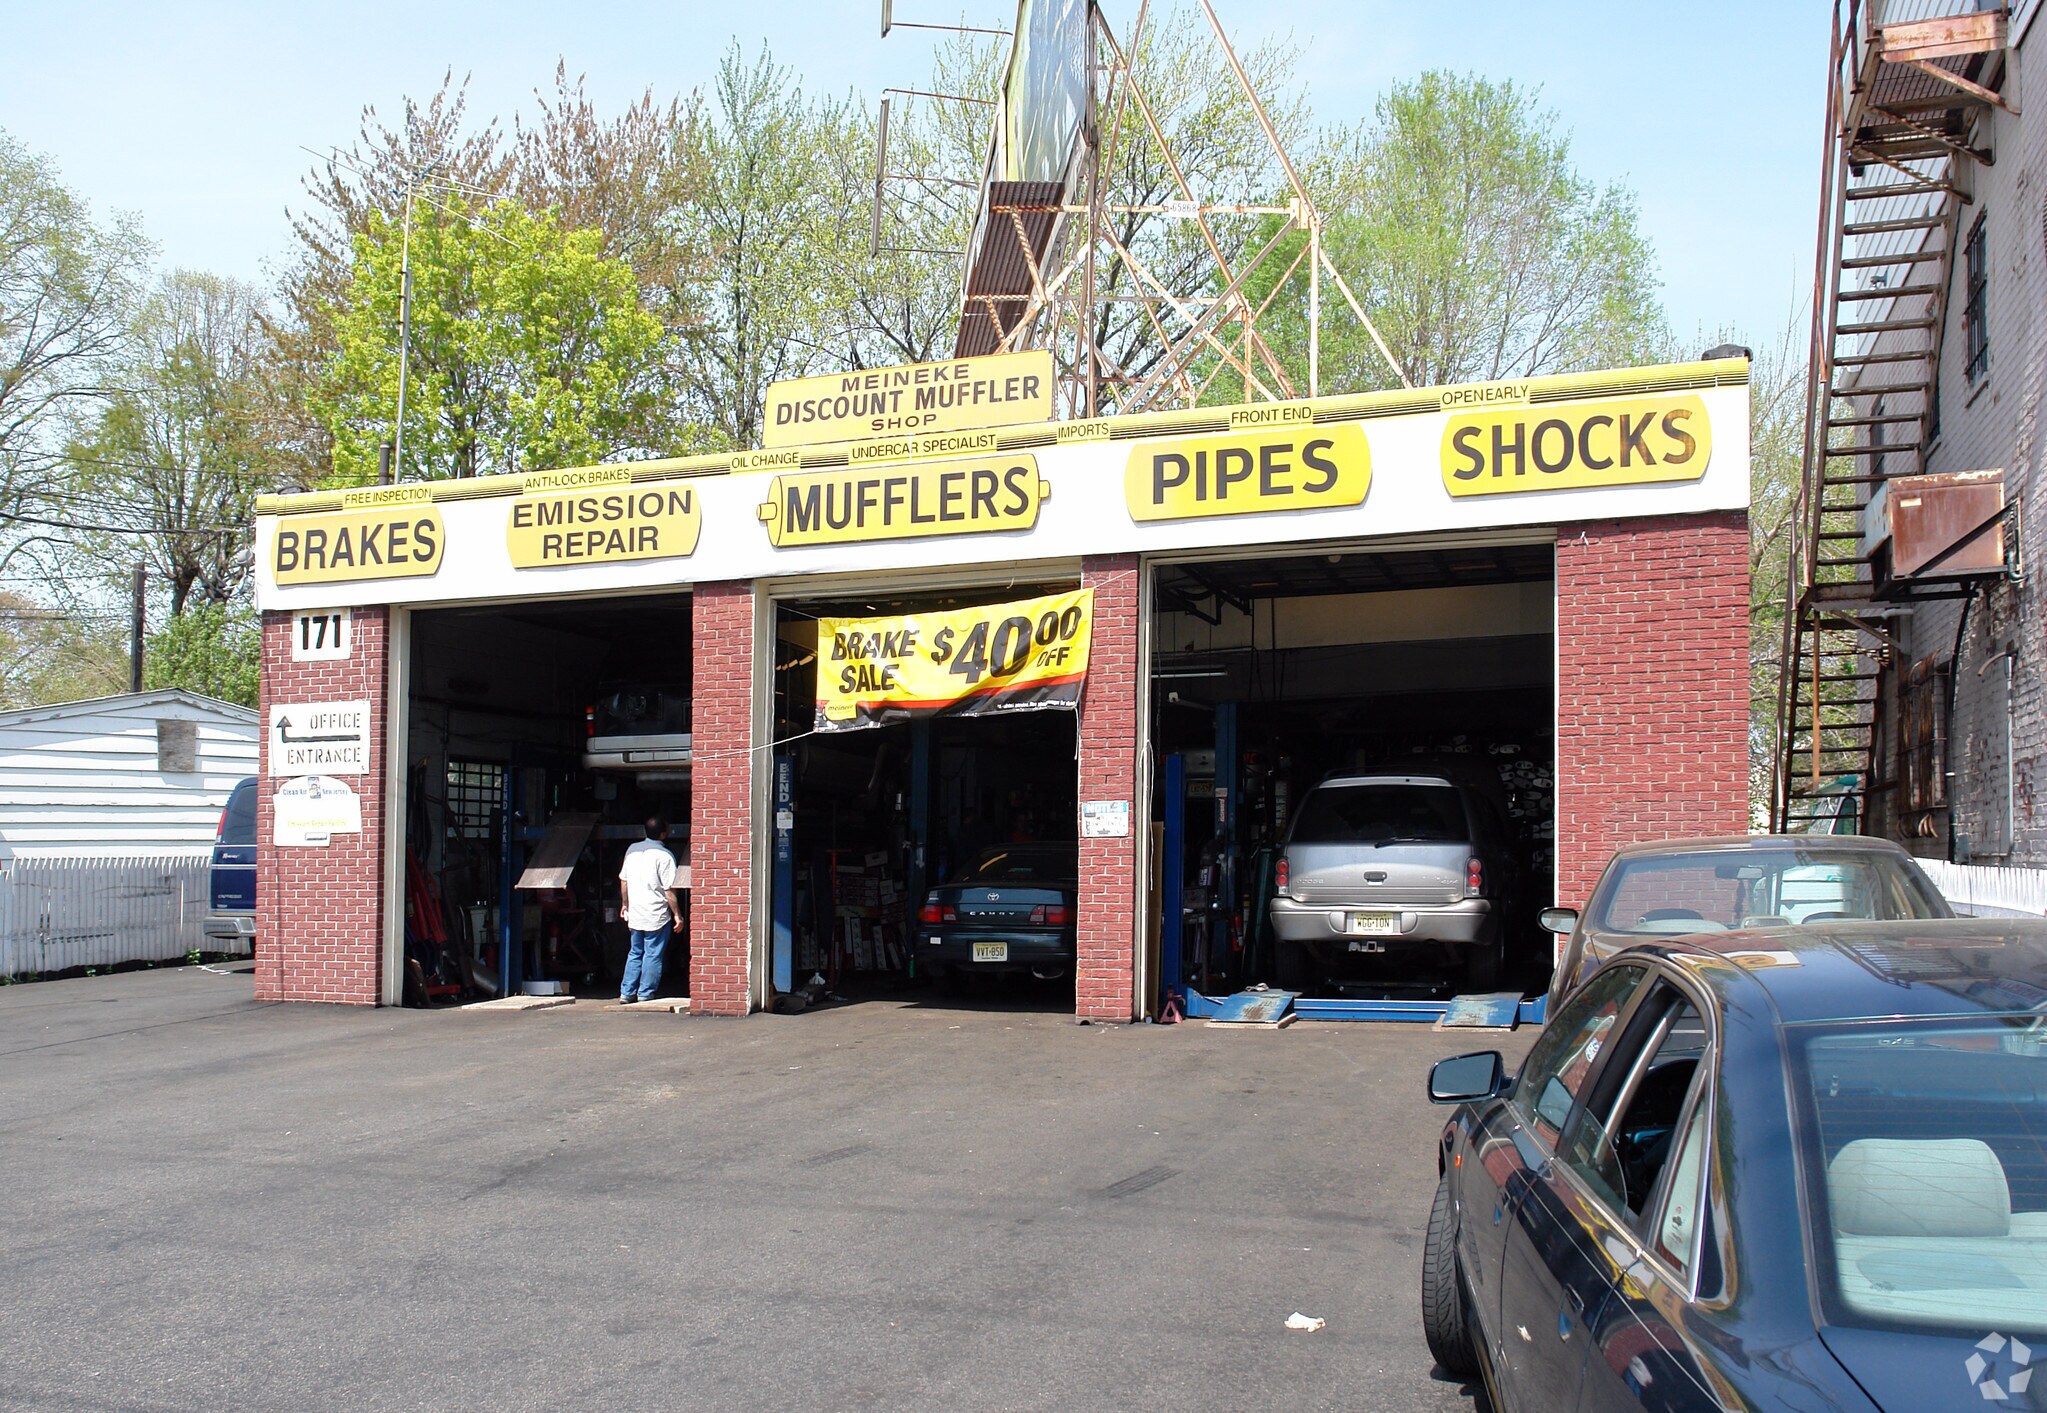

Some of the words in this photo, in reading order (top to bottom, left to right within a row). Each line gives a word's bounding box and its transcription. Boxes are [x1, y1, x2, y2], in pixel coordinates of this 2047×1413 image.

[841, 363, 970, 393] MEINEKE
[776, 389, 902, 426] DISCOUNT
[915, 374, 1040, 411] MUFFLER
[1441, 388, 1484, 405] OPEN
[1486, 384, 1529, 401] EARLY
[871, 413, 937, 431] SHOP
[1231, 408, 1281, 424] FRONT
[1283, 406, 1312, 421] END
[1057, 422, 1109, 439] IMPORTS
[1452, 408, 1697, 480] SHOCKS
[731, 455, 749, 469] OIL
[751, 452, 799, 468] CHANGE
[852, 438, 919, 459] UNDERCAR
[922, 434, 995, 453] SPECIALIST
[524, 471, 587, 489] ANTI-LOCK
[588, 467, 631, 484] BRAKES
[1153, 438, 1339, 505] PIPES
[344, 491, 371, 505] FREE
[372, 487, 432, 503] INSPECTION
[513, 489, 693, 528] EMISSION
[786, 466, 1030, 533] MUFFLERS
[276, 518, 436, 572] BRAKES
[543, 525, 659, 559] REPAIR
[300, 614, 341, 650] 171
[831, 629, 920, 661] BRAKE
[839, 663, 900, 694] SALE
[309, 712, 361, 730] OFFICE
[287, 747, 362, 765] ENTRANCE
